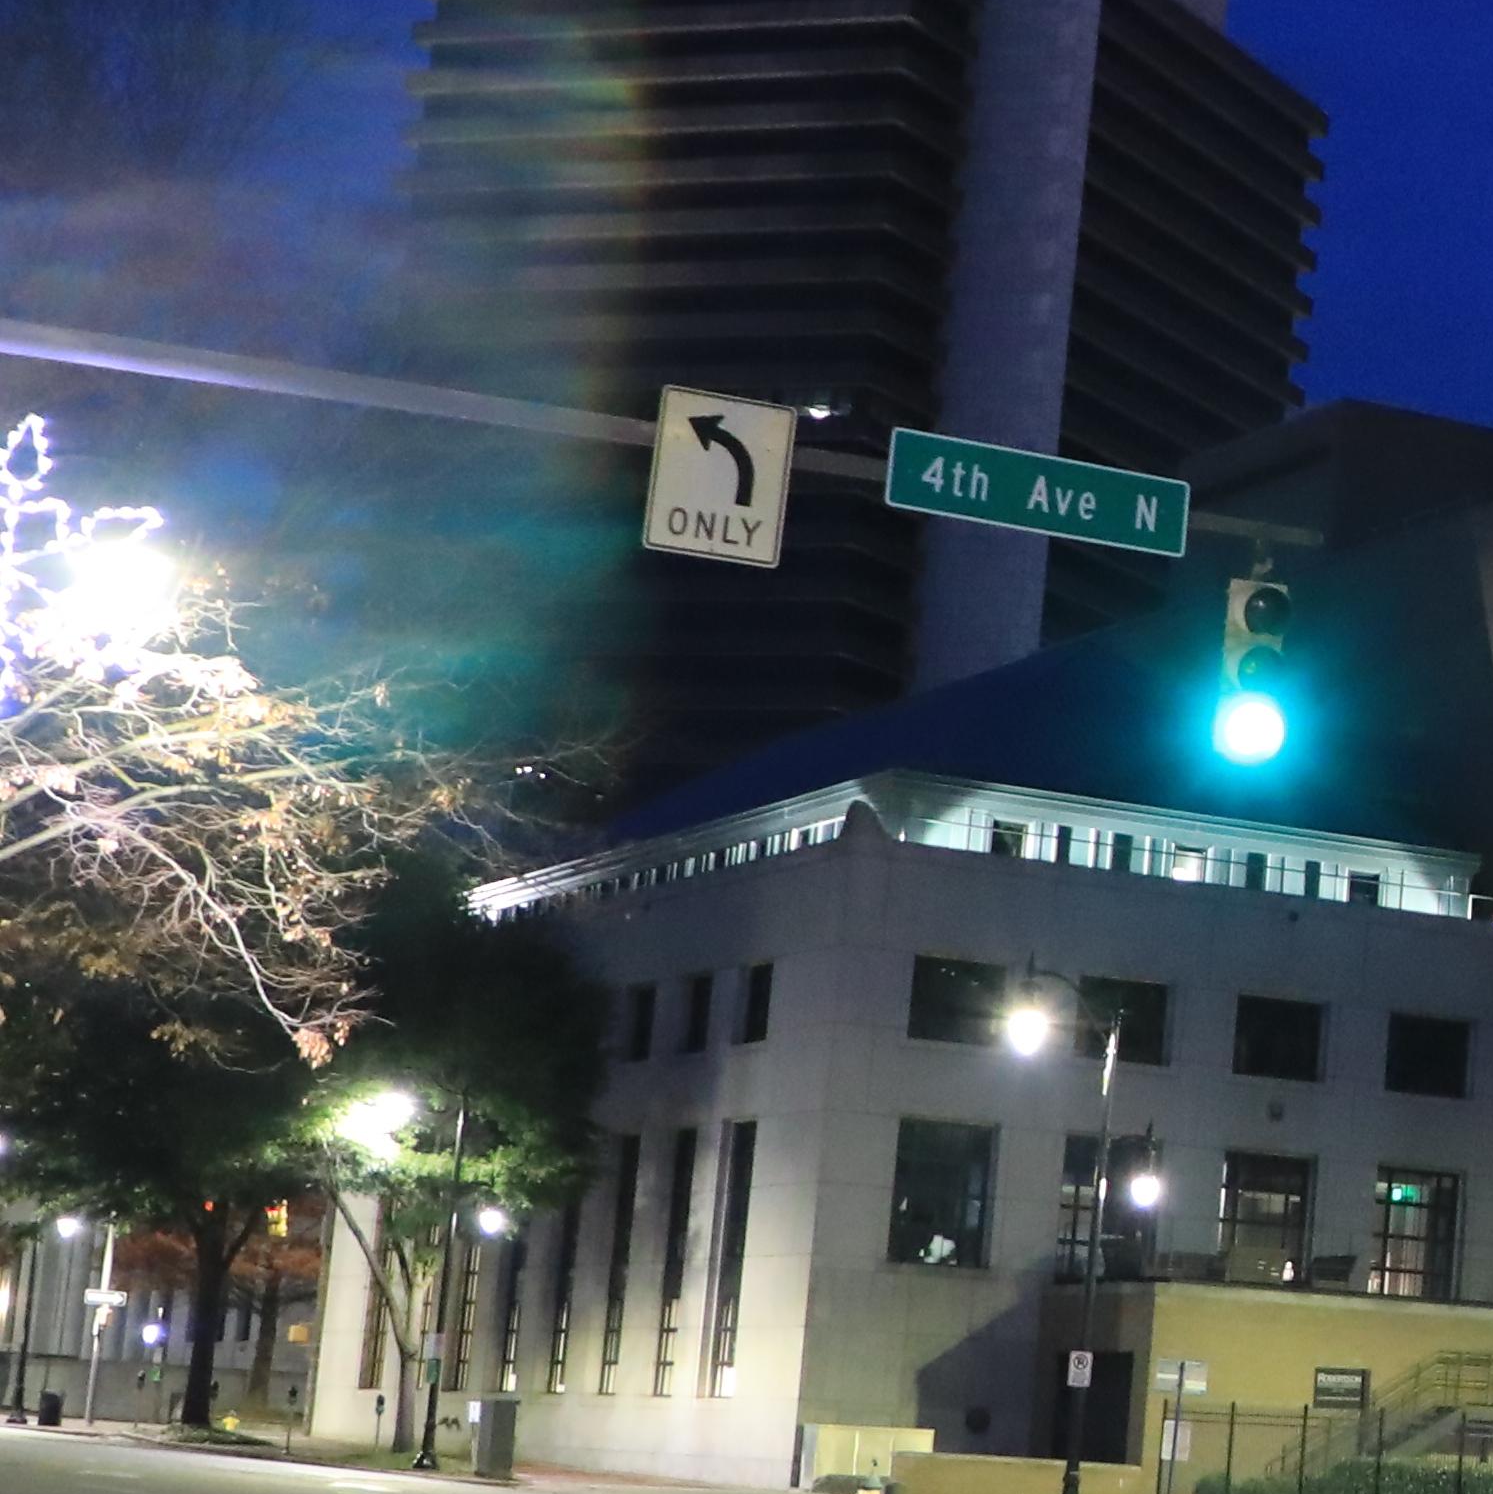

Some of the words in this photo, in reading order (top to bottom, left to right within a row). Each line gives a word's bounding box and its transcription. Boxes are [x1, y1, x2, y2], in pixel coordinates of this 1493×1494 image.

[921, 456, 989, 502] 4th
[1026, 475, 1098, 521] Ave
[1134, 494, 1158, 532] N
[668, 506, 763, 547] ONLY
